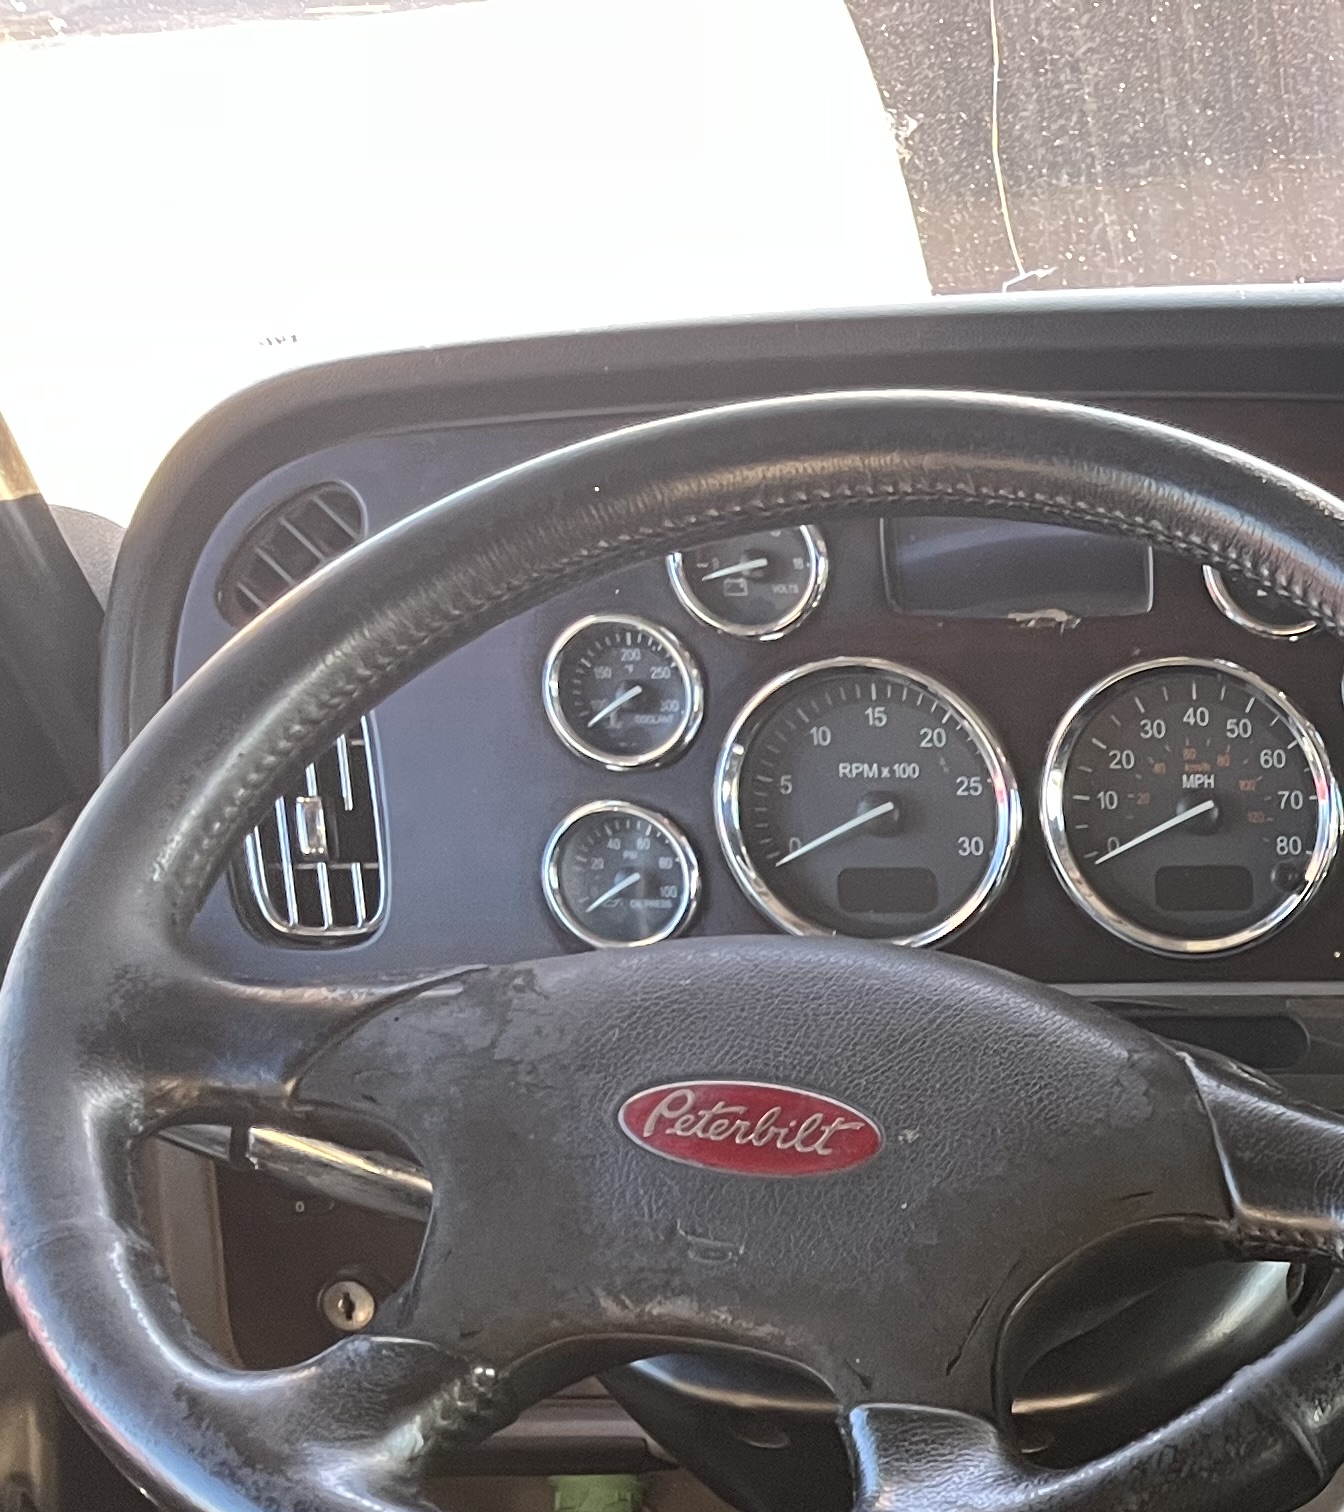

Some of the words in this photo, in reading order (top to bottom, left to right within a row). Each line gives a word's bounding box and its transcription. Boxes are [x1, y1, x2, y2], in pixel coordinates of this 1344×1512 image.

[864, 706, 887, 727] 15
[1183, 707, 1209, 727] 40
[810, 726, 831, 746] 10
[919, 727, 946, 748] 20
[1140, 719, 1166, 739] 30
[1226, 718, 1252, 739] 50
[1108, 750, 1135, 769] 20
[1260, 749, 1286, 769] 60
[838, 763, 878, 778] RPM
[892, 763, 920, 779] 100
[780, 775, 792, 795] 5
[956, 776, 983, 796] 25
[1182, 774, 1215, 789] MPH
[1097, 790, 1118, 810] 10
[1277, 790, 1303, 810] 70
[957, 836, 984, 856] 30
[1276, 836, 1302, 856] 80
[643, 1088, 865, 1156] Peterbilt
